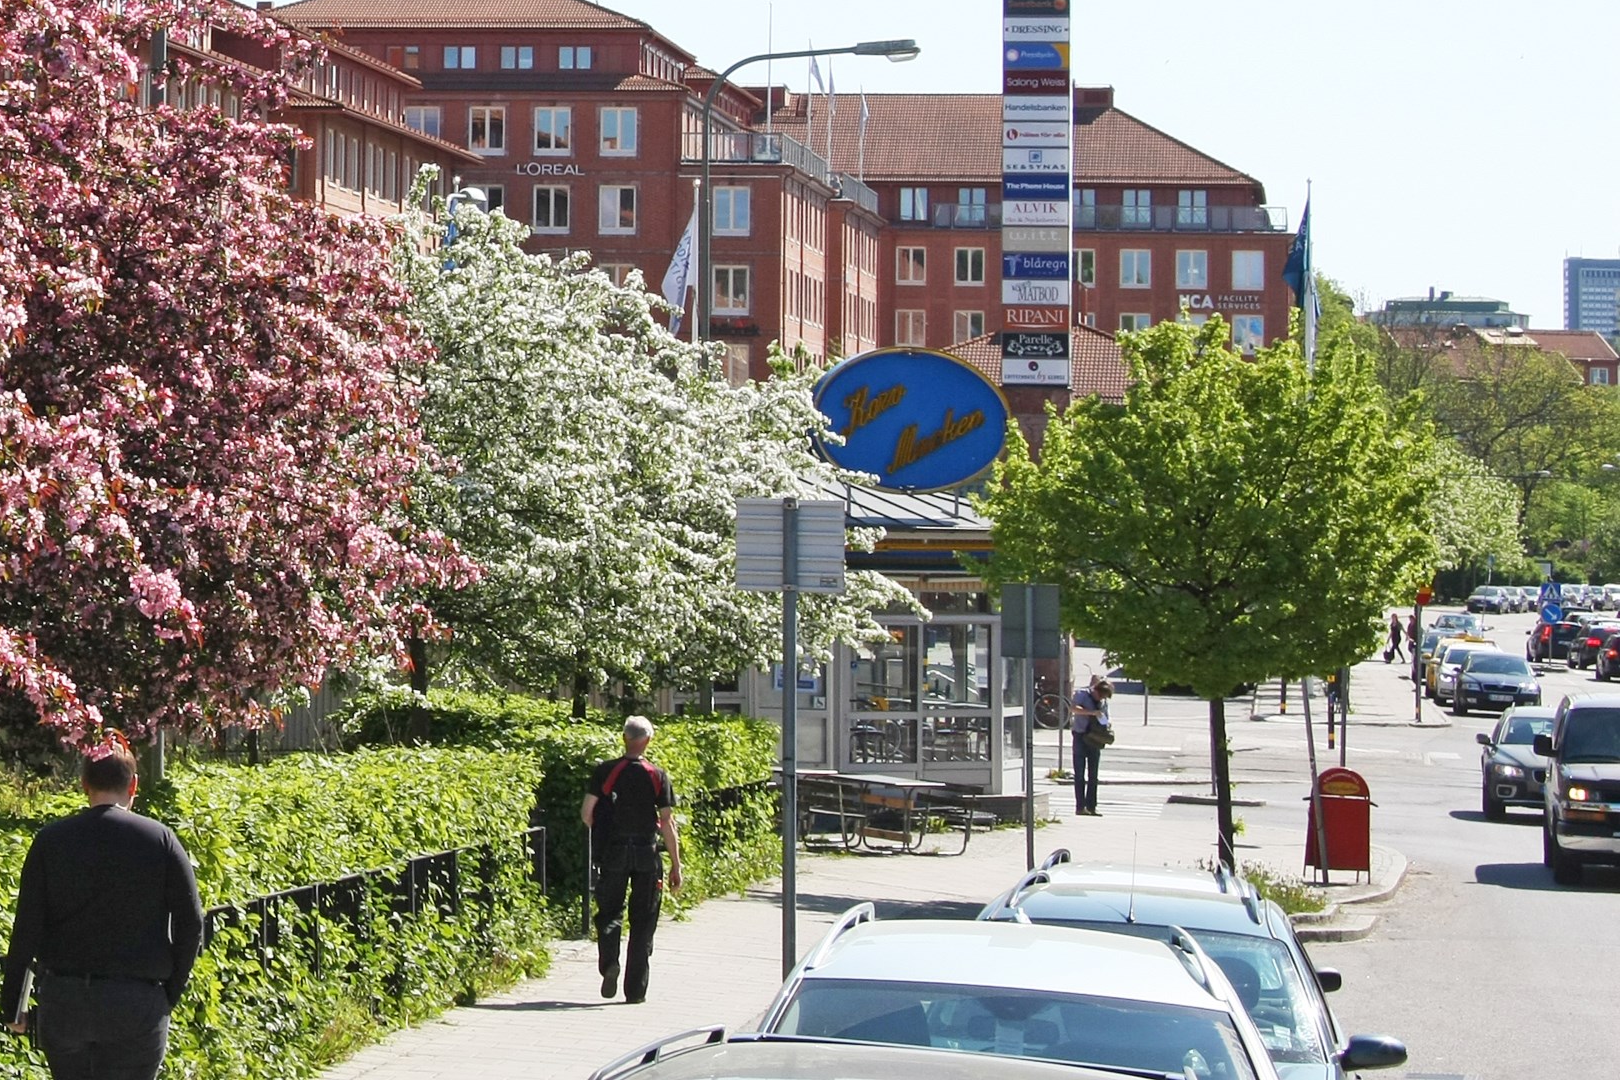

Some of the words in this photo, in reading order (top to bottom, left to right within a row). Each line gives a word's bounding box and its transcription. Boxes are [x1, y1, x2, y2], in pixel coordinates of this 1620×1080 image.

[1007, 77, 1039, 88] Salong
[1040, 78, 1066, 87] Weiss
[1005, 103, 1067, 111] Handelsbanken
[1020, 182, 1042, 190] Phone
[1013, 203, 1058, 214] ALVIK
[1023, 257, 1067, 272] blåregn
[1017, 286, 1059, 301] MATBOD
[1217, 302, 1261, 310] SERVICES
[1006, 308, 1064, 323] RIPANI
[1018, 334, 1053, 345] Parelle
